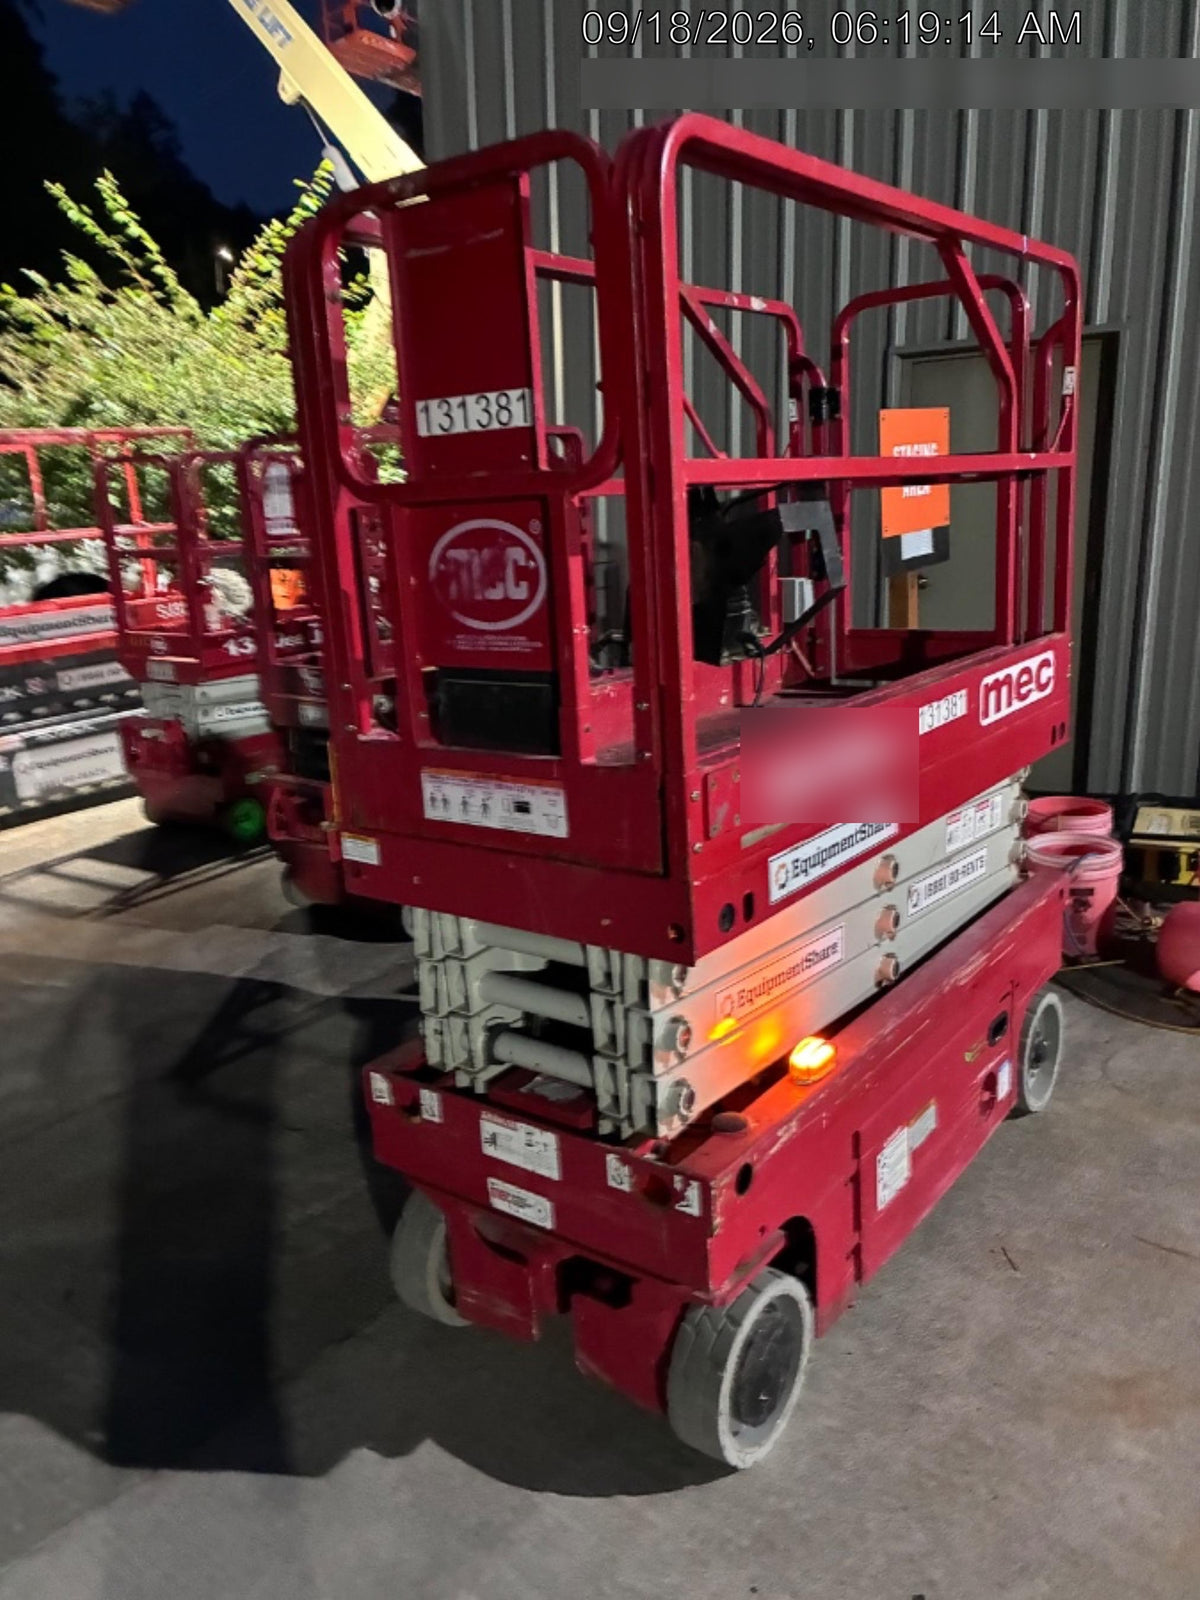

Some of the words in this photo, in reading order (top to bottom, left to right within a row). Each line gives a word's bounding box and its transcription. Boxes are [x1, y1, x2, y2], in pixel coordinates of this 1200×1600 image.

[419, 388, 529, 435] 131381
[919, 693, 968, 731] 131381
[737, 941, 839, 1009] EquipmentShare
